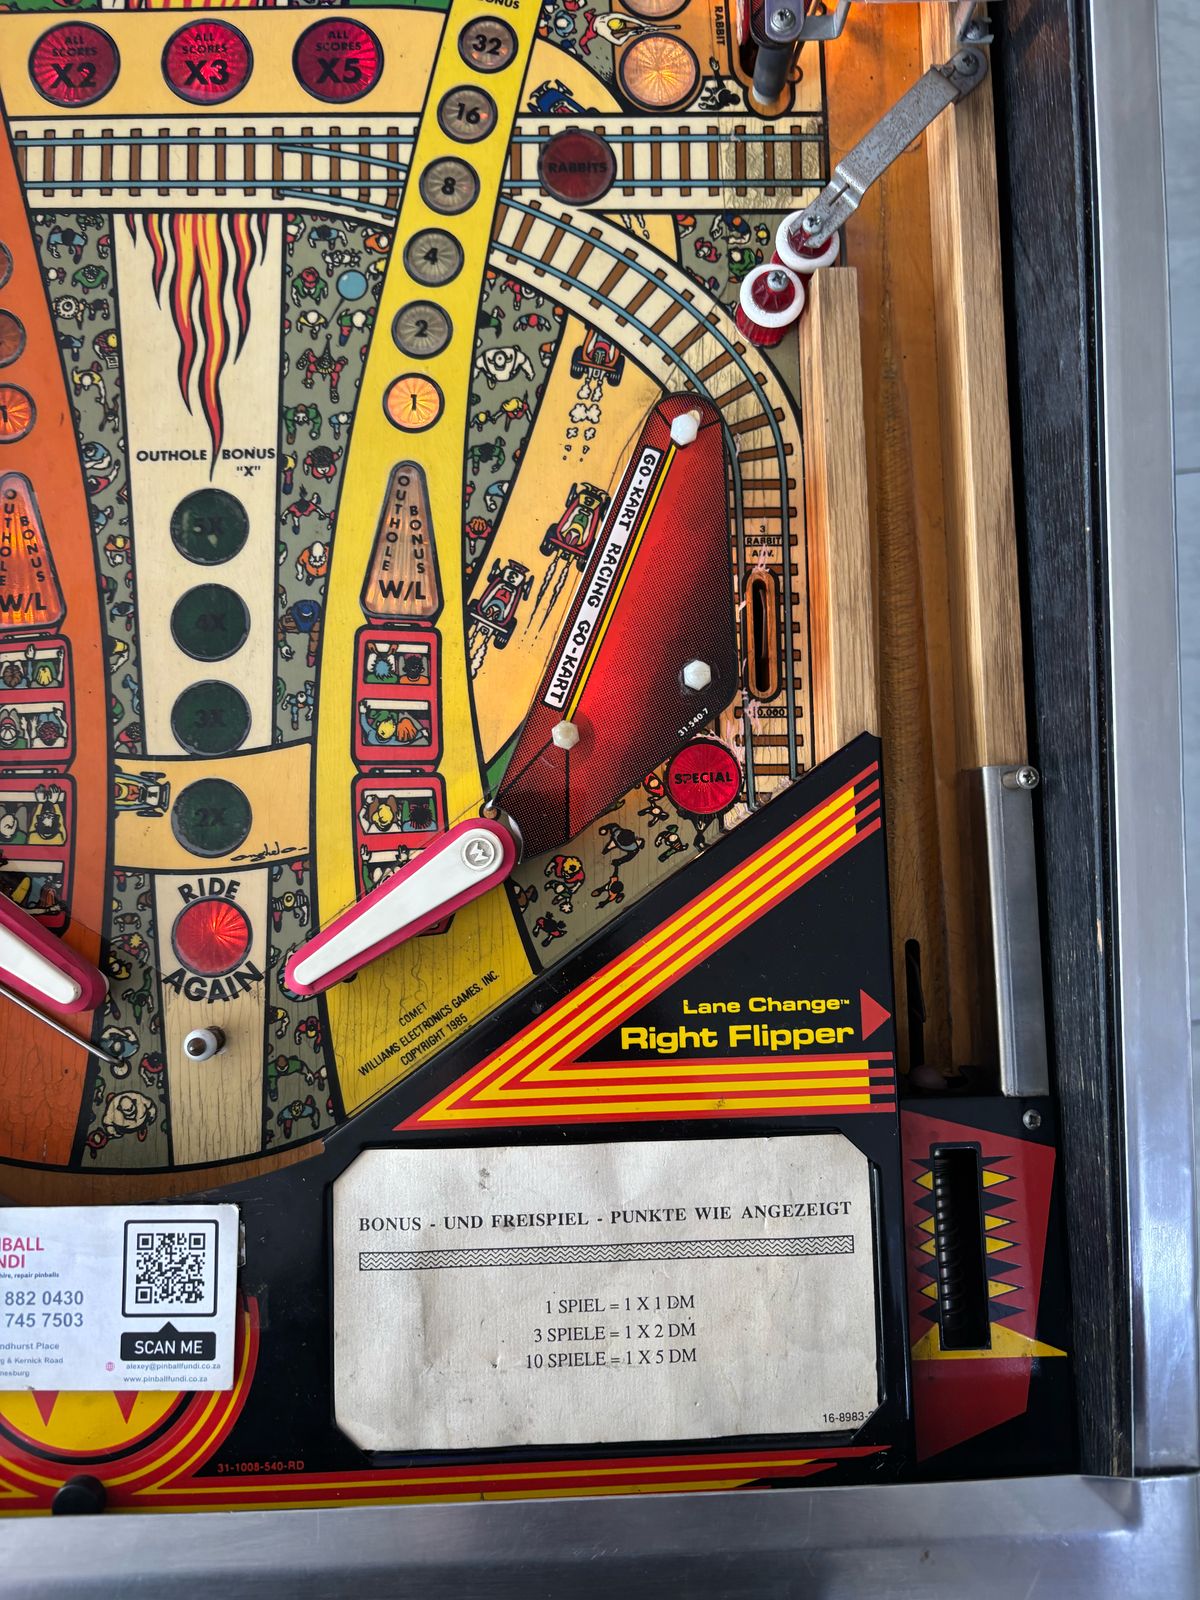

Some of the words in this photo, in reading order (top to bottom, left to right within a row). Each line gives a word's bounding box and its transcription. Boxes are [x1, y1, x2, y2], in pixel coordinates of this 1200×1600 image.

[327, 30, 350, 40] ALL
[714, 5, 726, 46] RABBIT
[64, 36, 85, 46] ALL
[194, 33, 215, 43] ALL
[316, 40, 362, 51] SCORES
[472, 34, 502, 56] 32
[52, 46, 97, 57] SCORES
[182, 42, 227, 55] SCORES
[51, 62, 97, 89] X2
[184, 59, 229, 86] X3
[317, 57, 363, 84] X5
[456, 102, 481, 125] 16
[548, 161, 609, 174] RABBITS
[441, 177, 457, 195] 8
[423, 248, 439, 265] 4
[414, 320, 429, 338] 2
[410, 393, 418, 412] 1
[136, 450, 207, 462] OUTHOLE
[222, 448, 275, 460] BONUS
[616, 452, 657, 532] GO-KART
[382, 475, 410, 571] OUTHOLE
[760, 525, 765, 533] 3
[20, 516, 45, 582] BONUS
[409, 505, 426, 574] BONUS
[746, 537, 781, 545] RABBIT
[587, 542, 622, 609] RACING
[379, 580, 426, 601] W/L
[0, 592, 47, 613] W/L
[552, 619, 591, 704] GO-KART
[677, 707, 709, 737] 31-540-7
[674, 771, 733, 785] SPECIAL
[193, 807, 227, 828] 2X
[177, 877, 241, 904] RIDE
[161, 960, 265, 1004] AGAIN
[398, 1001, 428, 1027] COMET
[683, 999, 741, 1015] Lane
[358, 1042, 401, 1076] WILLIAMS
[399, 1005, 453, 1047] ELECTRONICS
[481, 970, 500, 987] INC.
[400, 1028, 446, 1066] COPYRIGHT
[446, 1013, 469, 1032] 1985
[621, 1026, 718, 1054] Right
[729, 1024, 855, 1051] Flipper
[359, 1216, 422, 1231] BONUS
[444, 1215, 484, 1230] UND
[491, 1212, 590, 1228] FREISPIEL
[611, 1208, 687, 1224] PUNKTE
[695, 1206, 732, 1220] WIE
[741, 1201, 852, 1219] ANGEZEIGT
[0, 1237, 44, 1251] BALL
[34, 1271, 59, 1279] pinballs
[5, 1291, 36, 1306] 882
[42, 1290, 84, 1306] 0430
[546, 1301, 552, 1314] 1
[558, 1299, 606, 1314] SPIEL
[624, 1298, 631, 1311] 1
[637, 1297, 649, 1311] X
[655, 1297, 661, 1310] 1
[667, 1295, 695, 1310] DM
[5, 1313, 36, 1328] 745
[42, 1312, 84, 1327] 7503
[534, 1329, 542, 1343] 3
[547, 1326, 606, 1342] SPIELE
[625, 1326, 632, 1339] 1
[638, 1324, 650, 1338] X
[654, 1324, 664, 1338] 2
[668, 1323, 696, 1338] DM
[36, 1341, 60, 1350] Place
[134, 1340, 176, 1354] SCAN
[180, 1340, 203, 1354] ME
[45, 1356, 64, 1364] Road
[526, 1354, 543, 1369] 10
[548, 1352, 606, 1368] SPIELE
[626, 1352, 632, 1365] 1
[638, 1351, 651, 1365] X
[655, 1350, 664, 1364] 5
[669, 1348, 697, 1364] DM
[123, 1375, 208, 1383] www.pinballfundi.co.za
[217, 1460, 305, 1473] 31-1008-540-RD
